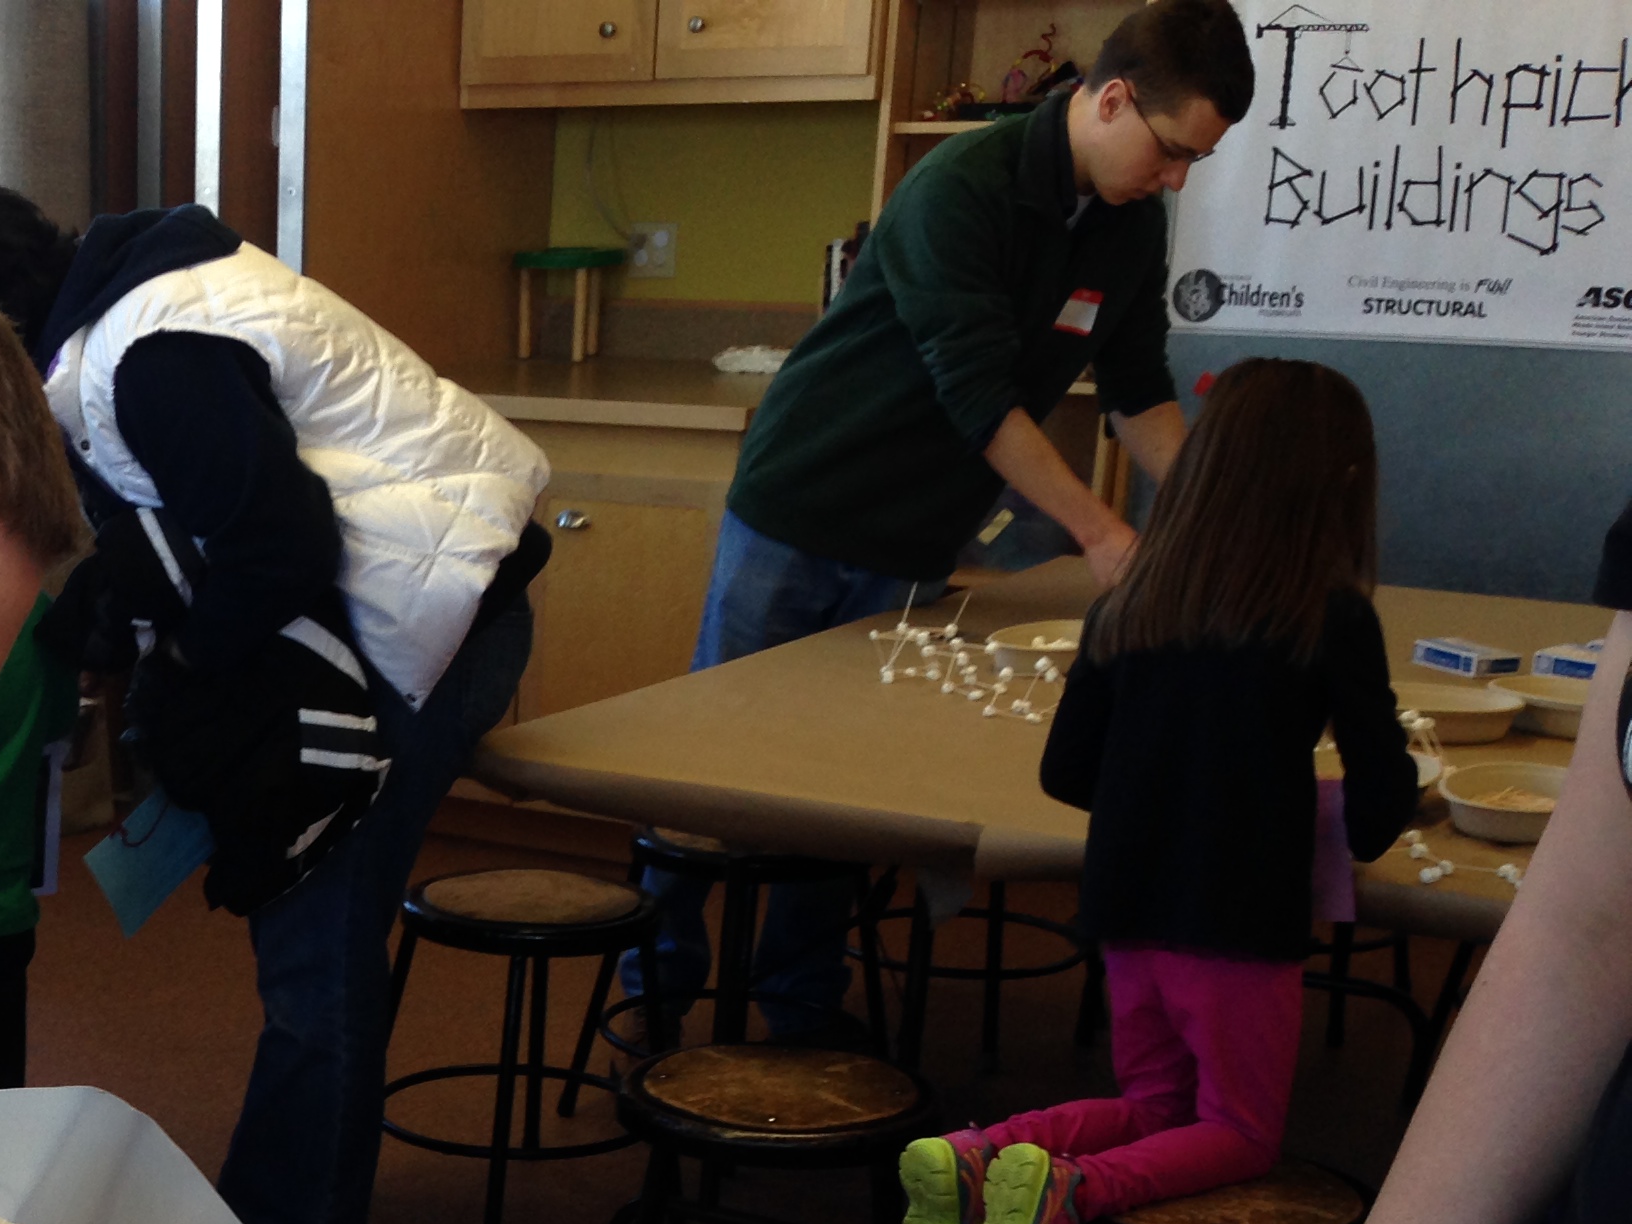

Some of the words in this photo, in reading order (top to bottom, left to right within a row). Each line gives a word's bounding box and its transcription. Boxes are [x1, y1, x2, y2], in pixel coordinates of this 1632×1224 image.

[1264, 144, 1606, 256] Buildings
[1219, 283, 1305, 308] Children's
[1347, 275, 1379, 289] Civil
[1381, 276, 1456, 293] Engineering
[1362, 297, 1488, 318] STRUCTURAL
